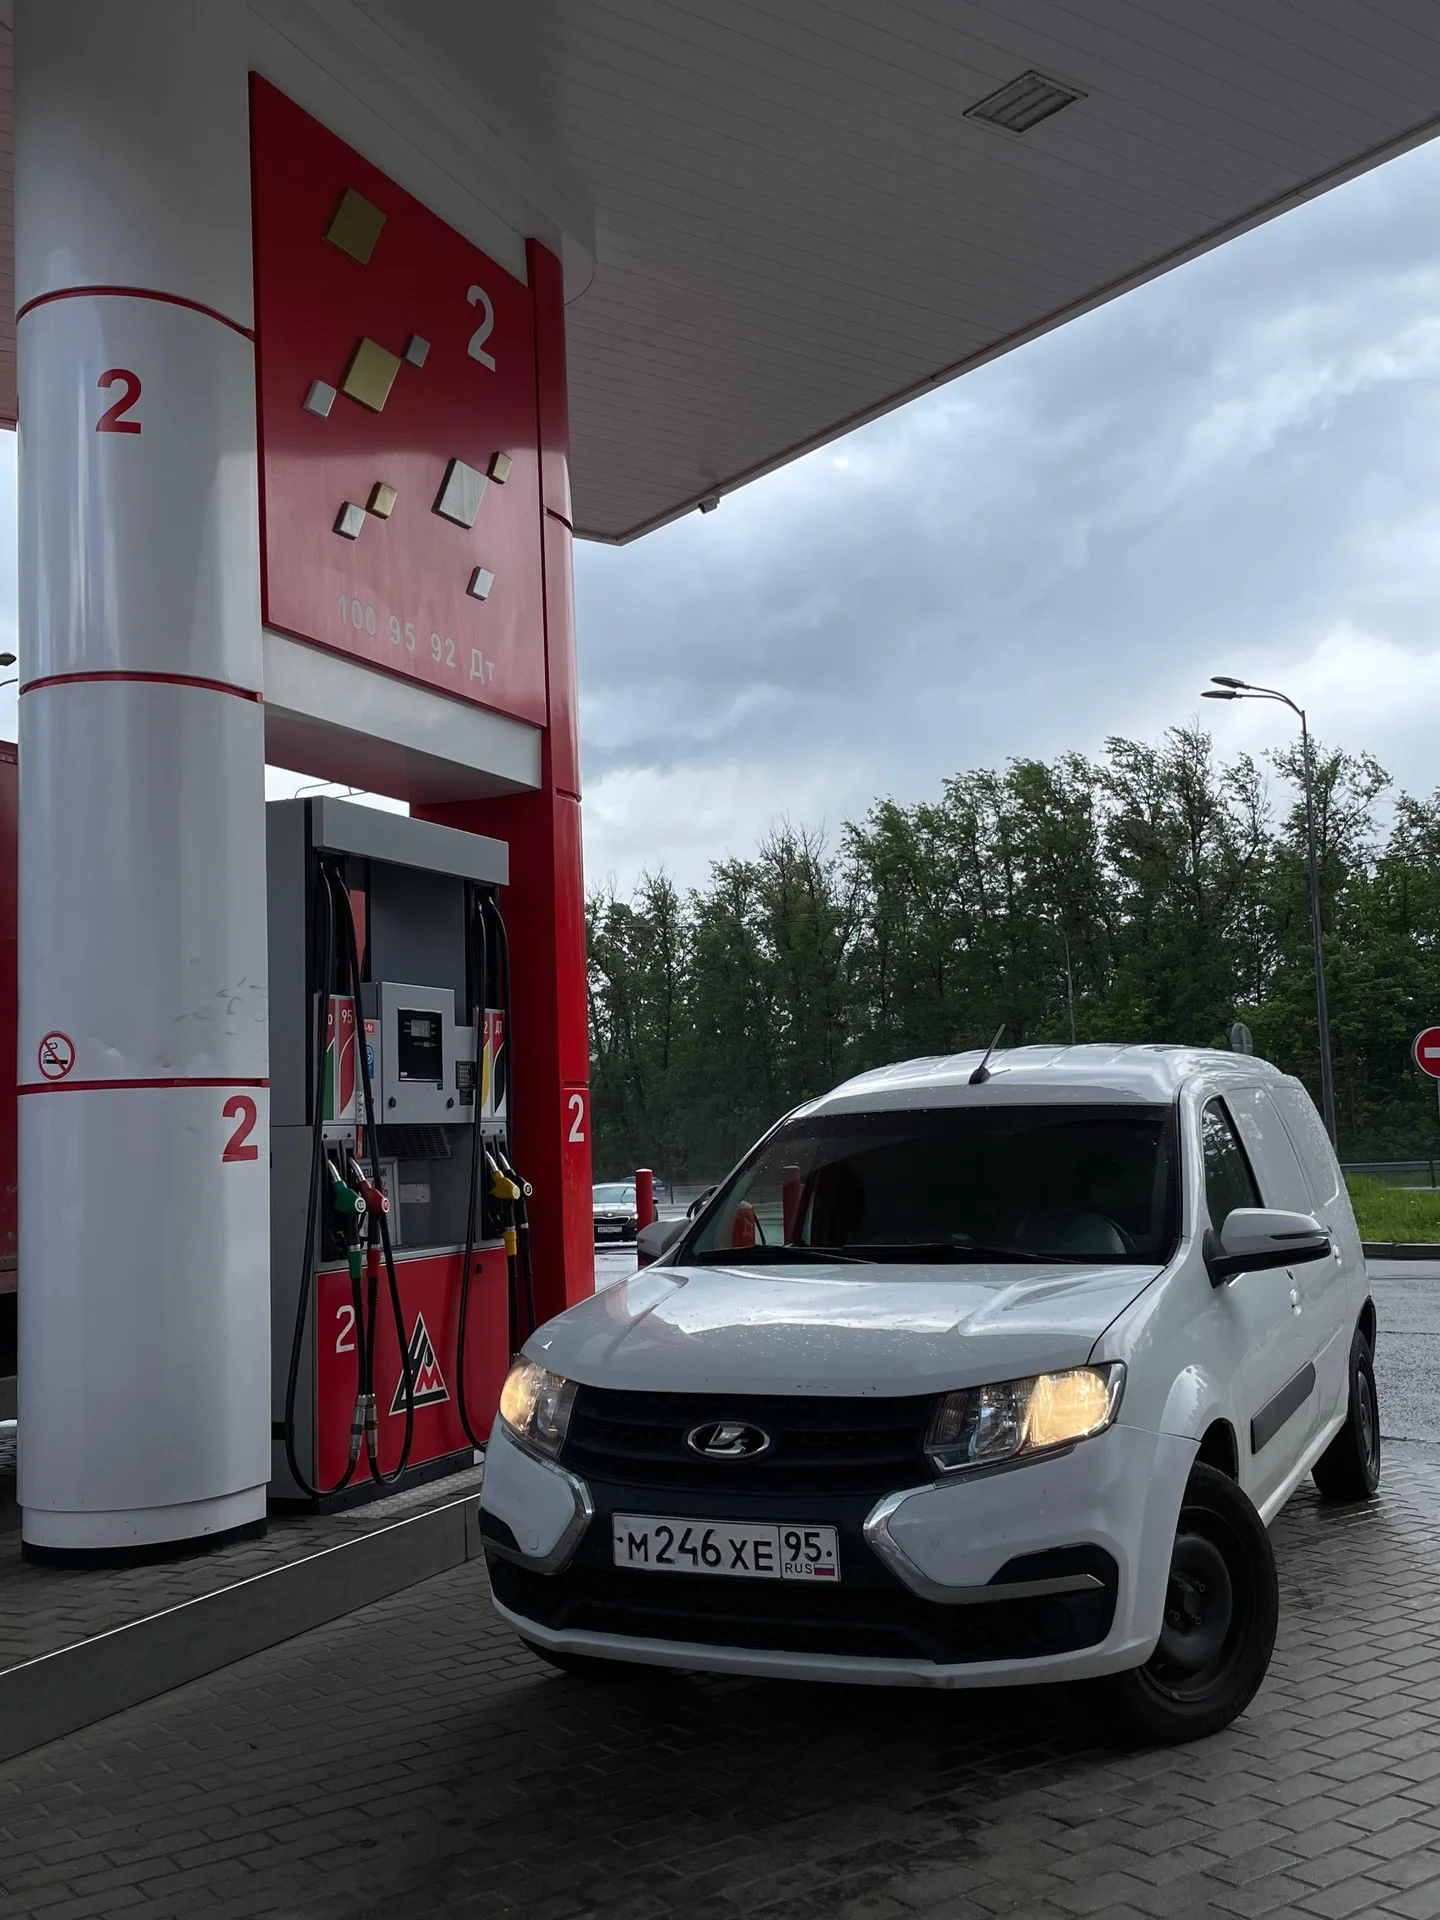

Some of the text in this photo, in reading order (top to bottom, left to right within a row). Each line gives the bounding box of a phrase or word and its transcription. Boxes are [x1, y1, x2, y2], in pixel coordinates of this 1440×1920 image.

[467, 284, 495, 372] 2
[95, 367, 141, 435] 2
[337, 593, 376, 636] 100
[388, 614, 416, 651] 95
[430, 632, 456, 668] 92
[341, 1009, 353, 1024] 95
[222, 1094, 258, 1163] 2
[568, 1093, 585, 1142] 2
[335, 1304, 355, 1353] 2
[627, 1525, 822, 1571] М246ХЕ 95
[784, 1563, 813, 1575] RUS
